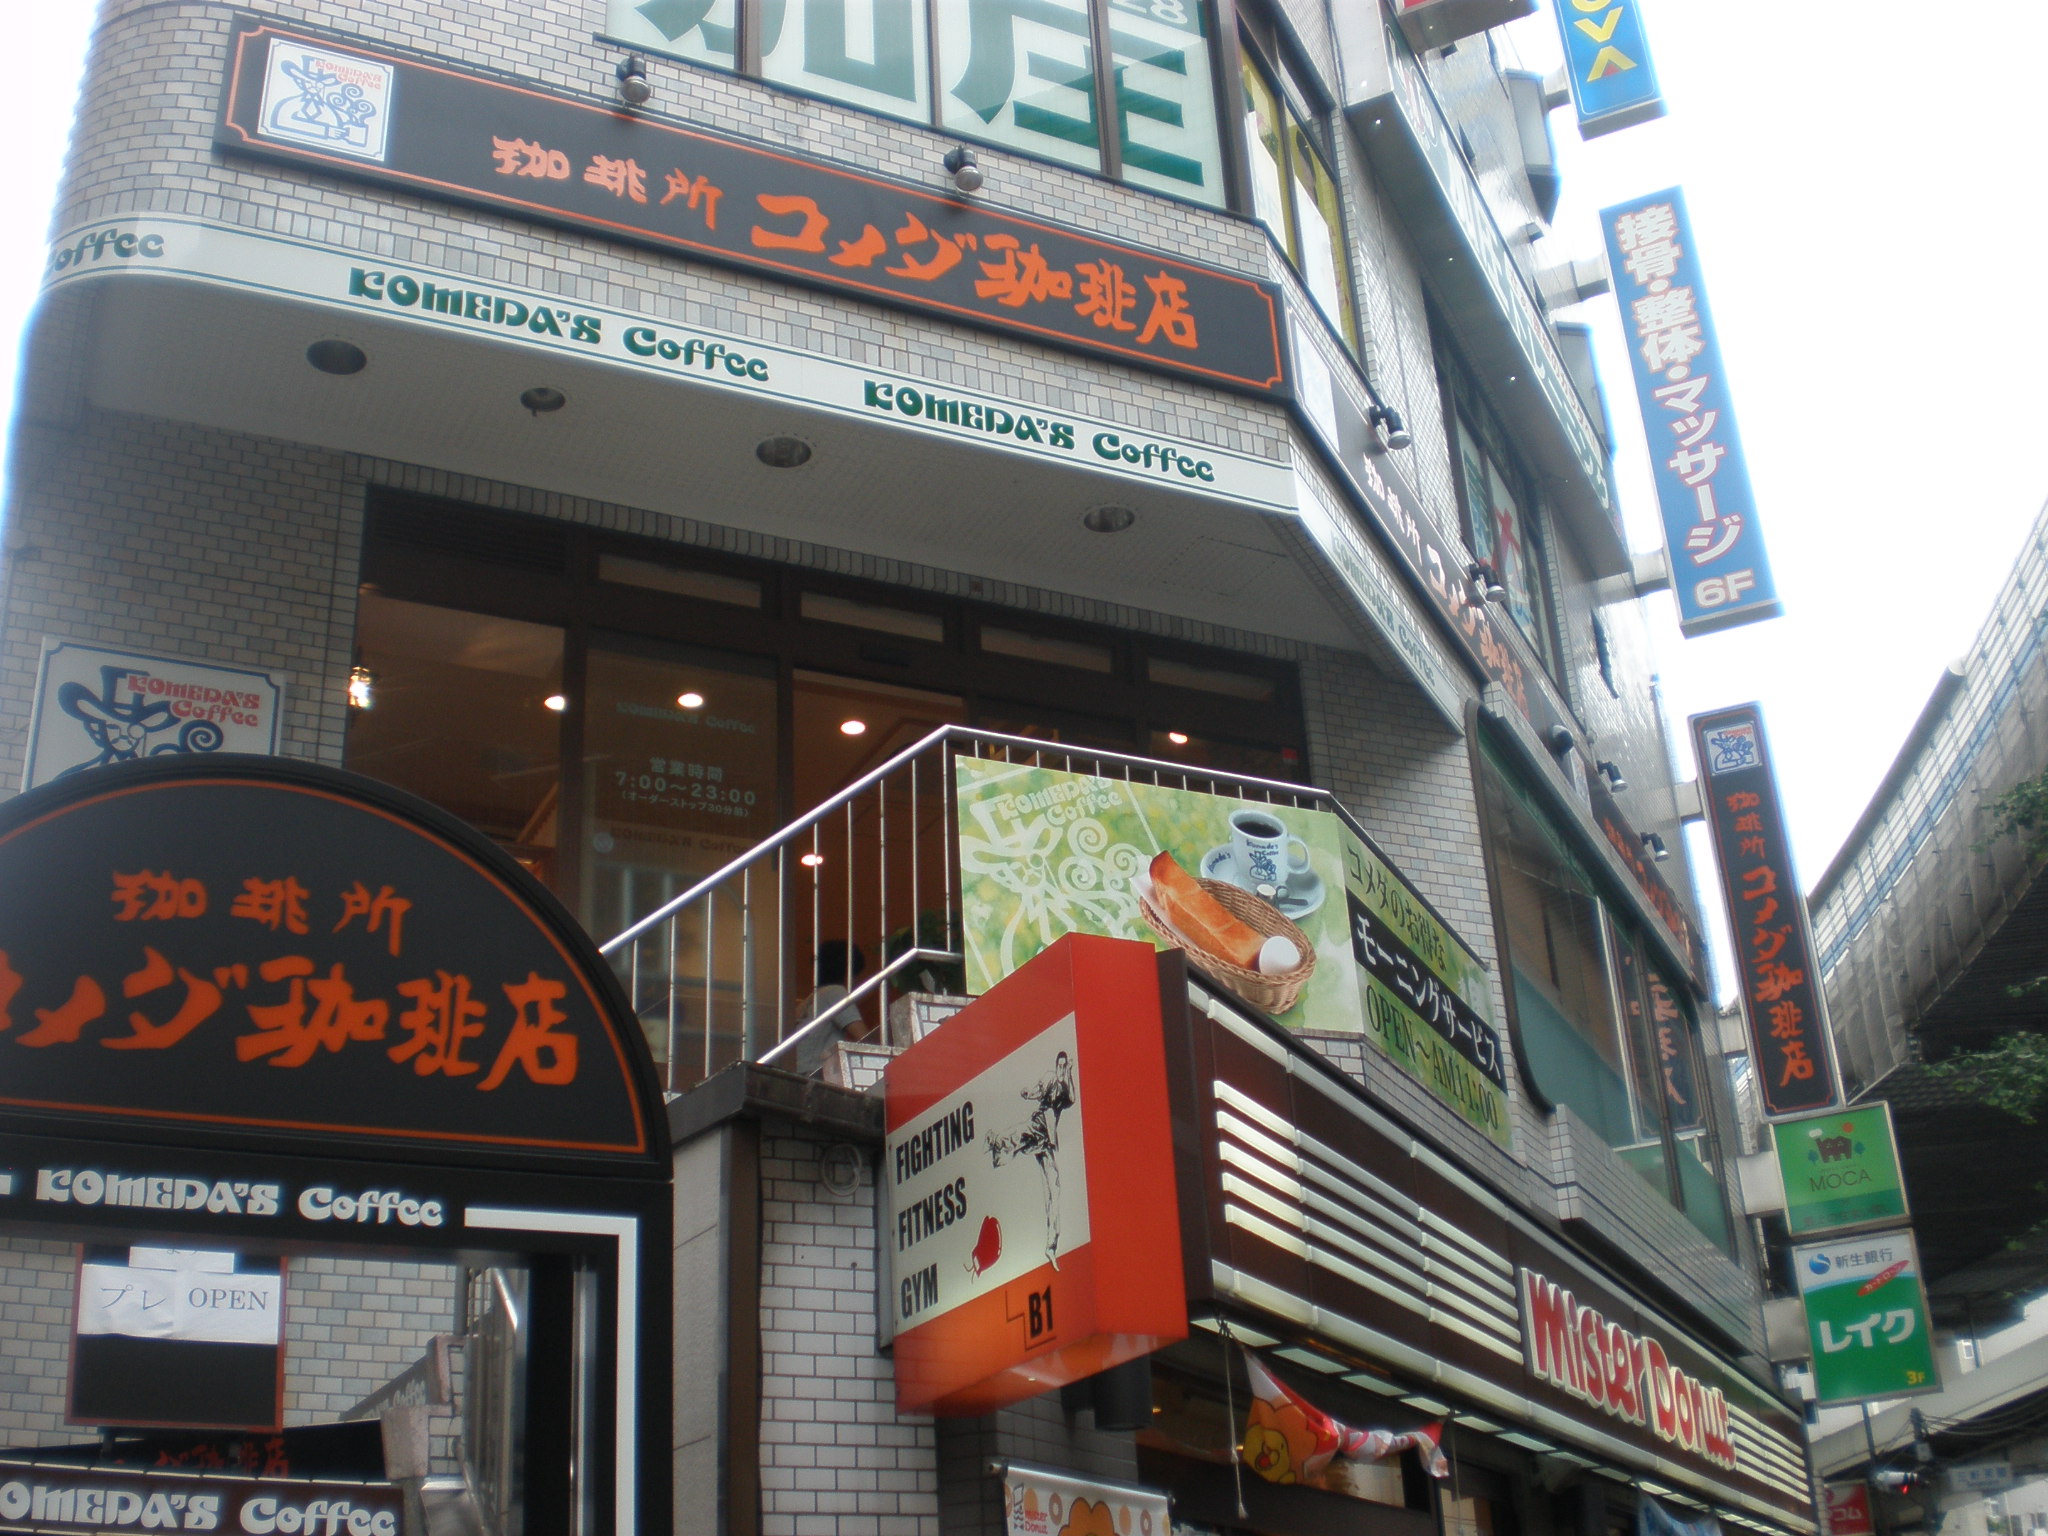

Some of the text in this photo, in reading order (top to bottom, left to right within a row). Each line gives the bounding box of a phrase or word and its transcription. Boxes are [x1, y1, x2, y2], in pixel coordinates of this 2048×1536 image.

[1571, 0, 1638, 82] VA
[50, 228, 165, 271] offee
[750, 194, 1198, 349] コメダ珈琲店
[348, 267, 770, 382] KOMEDA'S Coffee
[864, 380, 1215, 482] KOMEDA'S Coffee
[1695, 569, 1756, 608] 6F
[127, 675, 260, 710] KOMEDA'S
[172, 700, 258, 727] Coffee
[650, 757, 723, 783] 営業時間
[112, 869, 412, 957] 珈琲所
[1349, 849, 1446, 973] コメダのお得な
[1357, 913, 1501, 1080] モーニングサービス
[1741, 866, 1816, 1088] コメダ珈琲店
[895, 1101, 975, 1185] FIGHTING
[37, 1169, 443, 1227] KOMEDA'S Coffee
[1810, 1168, 1873, 1192] MOCA
[898, 1176, 967, 1252] FITNESS
[1835, 1247, 1893, 1269] 新生銀行
[100, 1283, 270, 1312] プレ OPEN
[901, 1263, 939, 1320] GYM
[1028, 1285, 1053, 1339] B1
[1820, 1309, 1916, 1353] レイク
[1907, 1370, 1926, 1386] 3F
[0, 1481, 396, 1536] OMEDA'S Coffee
